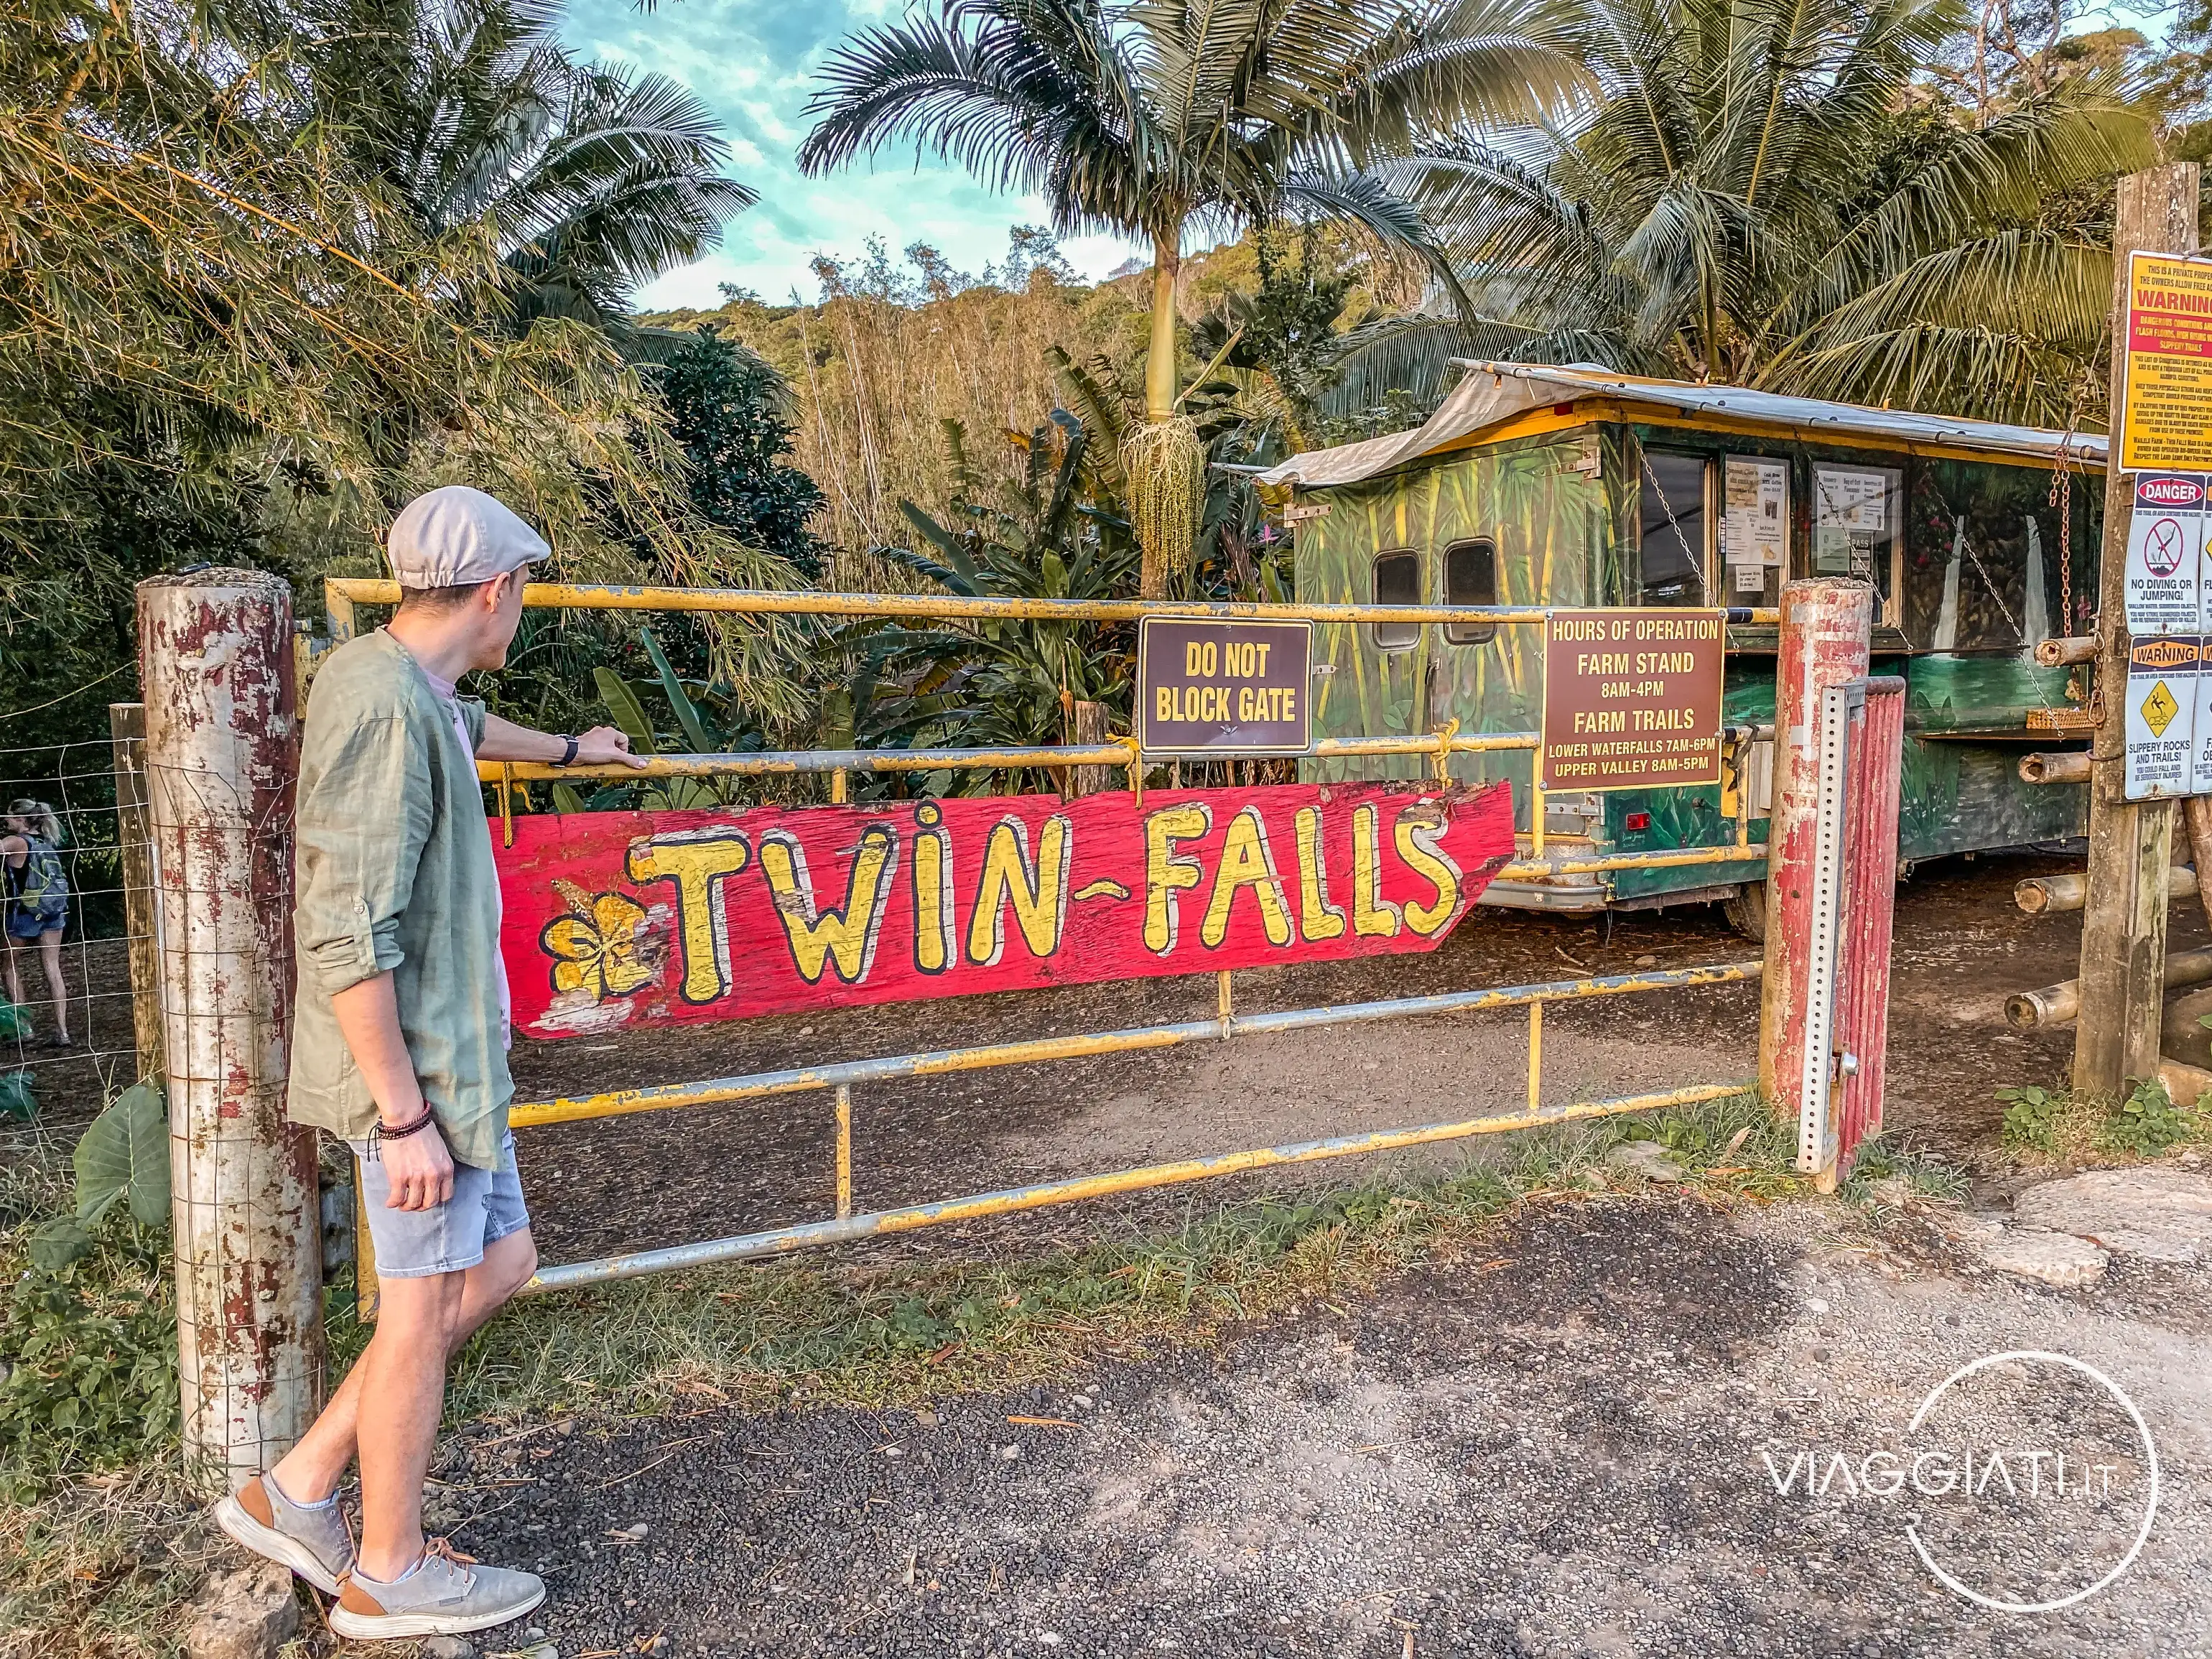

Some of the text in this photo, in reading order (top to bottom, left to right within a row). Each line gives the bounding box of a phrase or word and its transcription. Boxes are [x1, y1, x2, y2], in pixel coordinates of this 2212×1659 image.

[2173, 268, 2193, 278] PRIVATE
[2140, 276, 2150, 284] THE
[2152, 277, 2174, 287] OWNERS
[2175, 279, 2193, 289] ALLOW
[2193, 282, 2205, 290] FREE
[2137, 289, 2212, 313] WARNIN
[2140, 316, 2203, 330] DANGEROUS CONDITIONS
[2136, 327, 2153, 336] FLASH
[2160, 340, 2202, 352] SLIPPERY TRAILS
[2146, 484, 2196, 501] DANGER
[2132, 580, 2192, 589] NO DIVING OR
[2141, 591, 2183, 600] JUMPING!
[1553, 620, 1718, 641] HOURS OF OPERATION
[1186, 641, 1270, 678] DO NOT
[2137, 647, 2194, 661] WARNING
[1578, 652, 1694, 675] FARM STAND
[1602, 681, 1664, 698] 8AM-4PM
[1156, 687, 1296, 722] BLOCK GATE
[1574, 708, 1694, 734] FARM TRAILS
[1548, 738, 1715, 758] LOWER WATERFALLS 7AM-6PM
[2129, 740, 2190, 753] SLIPPERY ROCKS
[2136, 752, 2181, 764] AND TRAILS!
[1555, 756, 1709, 777] UPPER VALLEY 8AM-5PM
